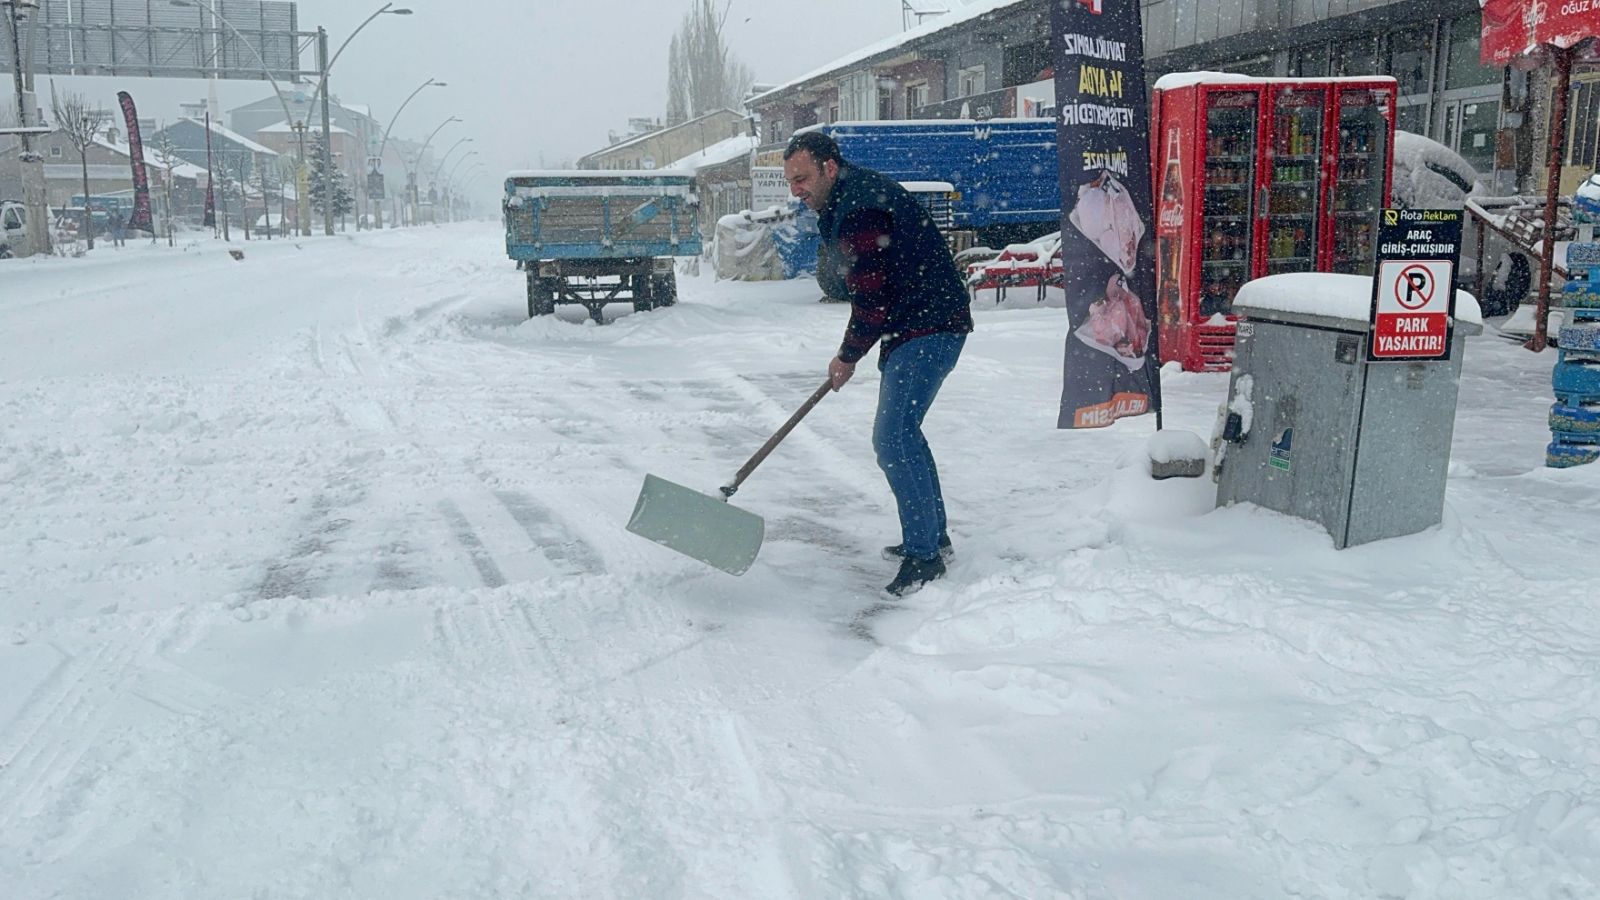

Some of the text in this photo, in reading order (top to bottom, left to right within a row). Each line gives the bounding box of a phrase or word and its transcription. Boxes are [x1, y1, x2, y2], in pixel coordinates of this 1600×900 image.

[1561, 1, 1589, 16] OĞUZ
[1407, 230, 1432, 242] ARAÇ
[1396, 318, 1429, 333] PARK
[1379, 336, 1442, 352] YASAKTIR!
